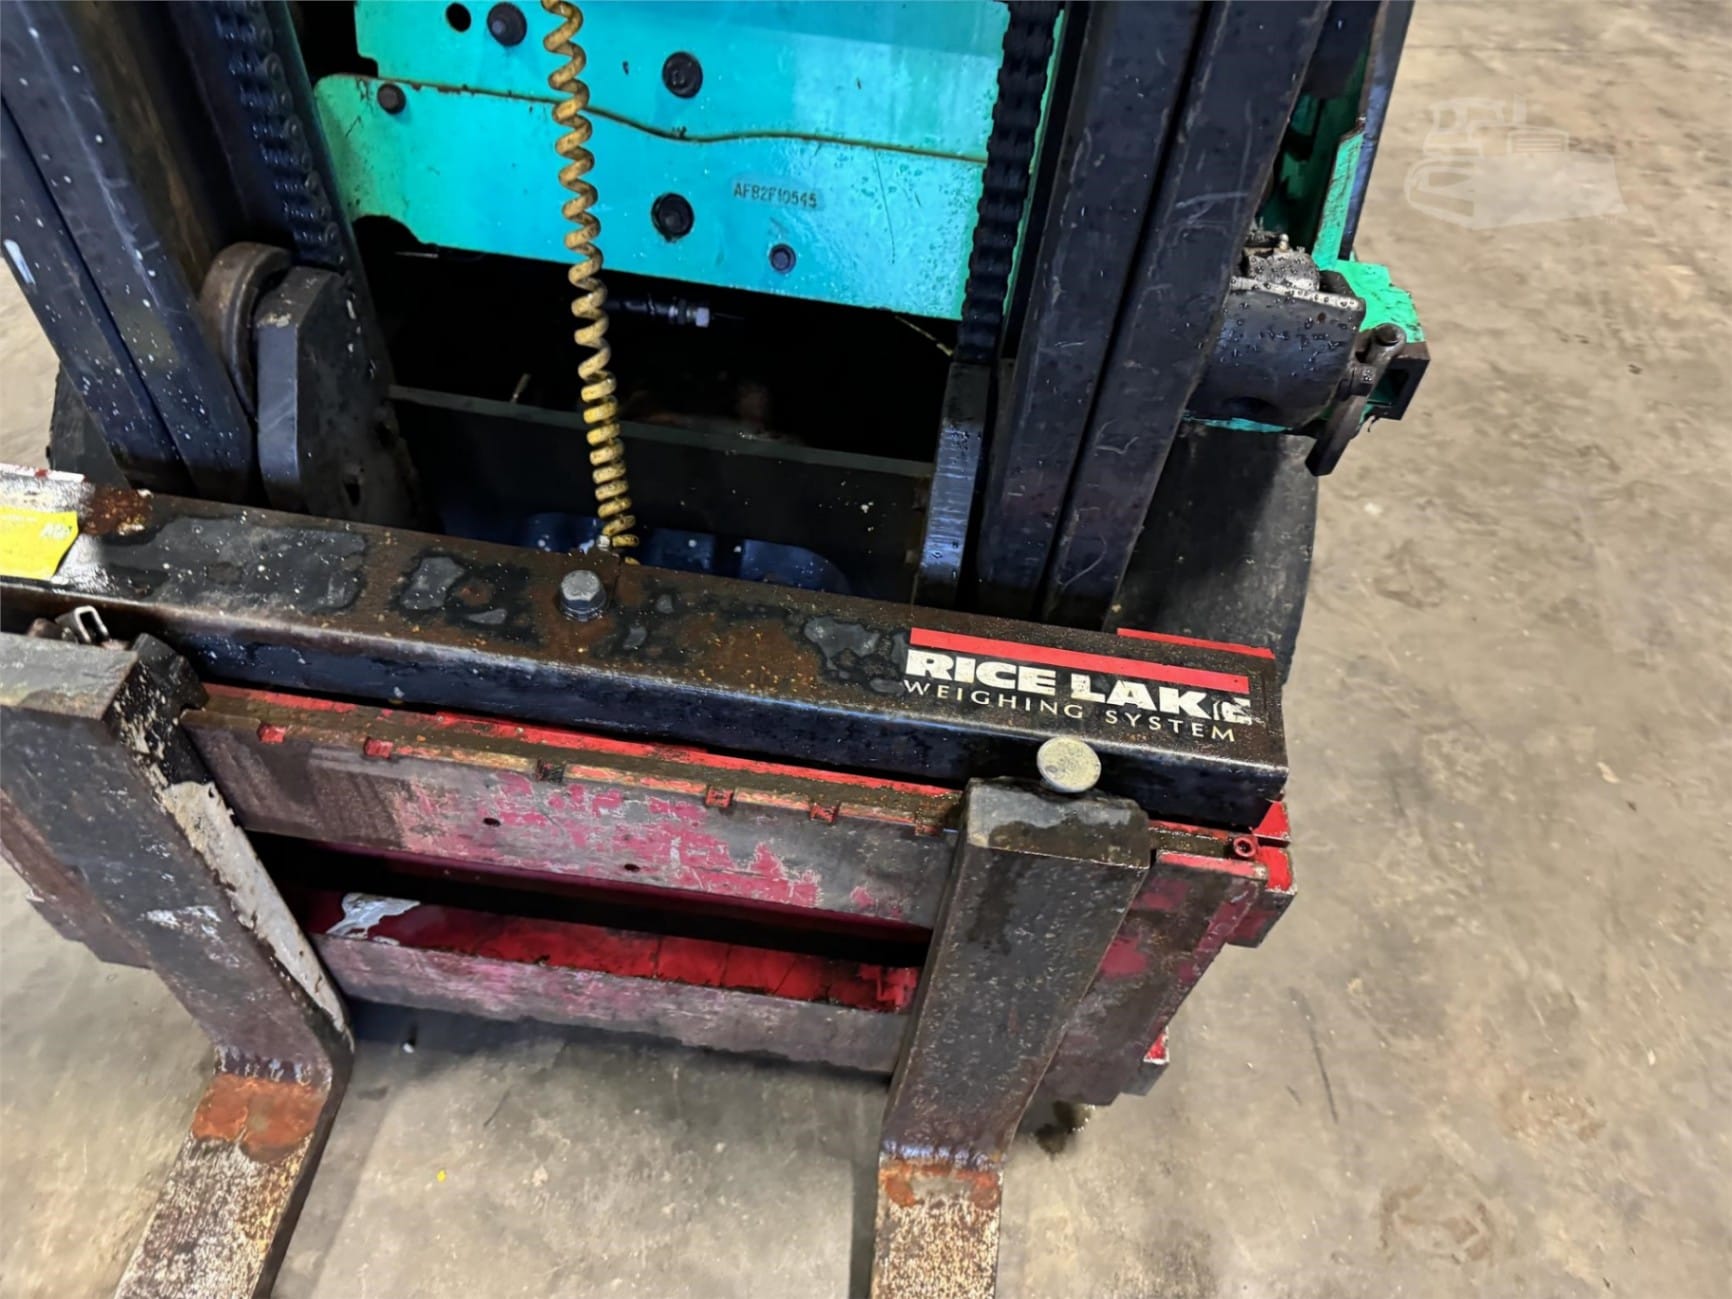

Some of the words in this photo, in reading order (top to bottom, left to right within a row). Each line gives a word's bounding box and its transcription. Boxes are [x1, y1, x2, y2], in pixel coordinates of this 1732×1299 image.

[905, 649, 1056, 696] RICE
[903, 680, 1083, 720] WEIGHING
[1105, 709, 1235, 742] SYSTEM
